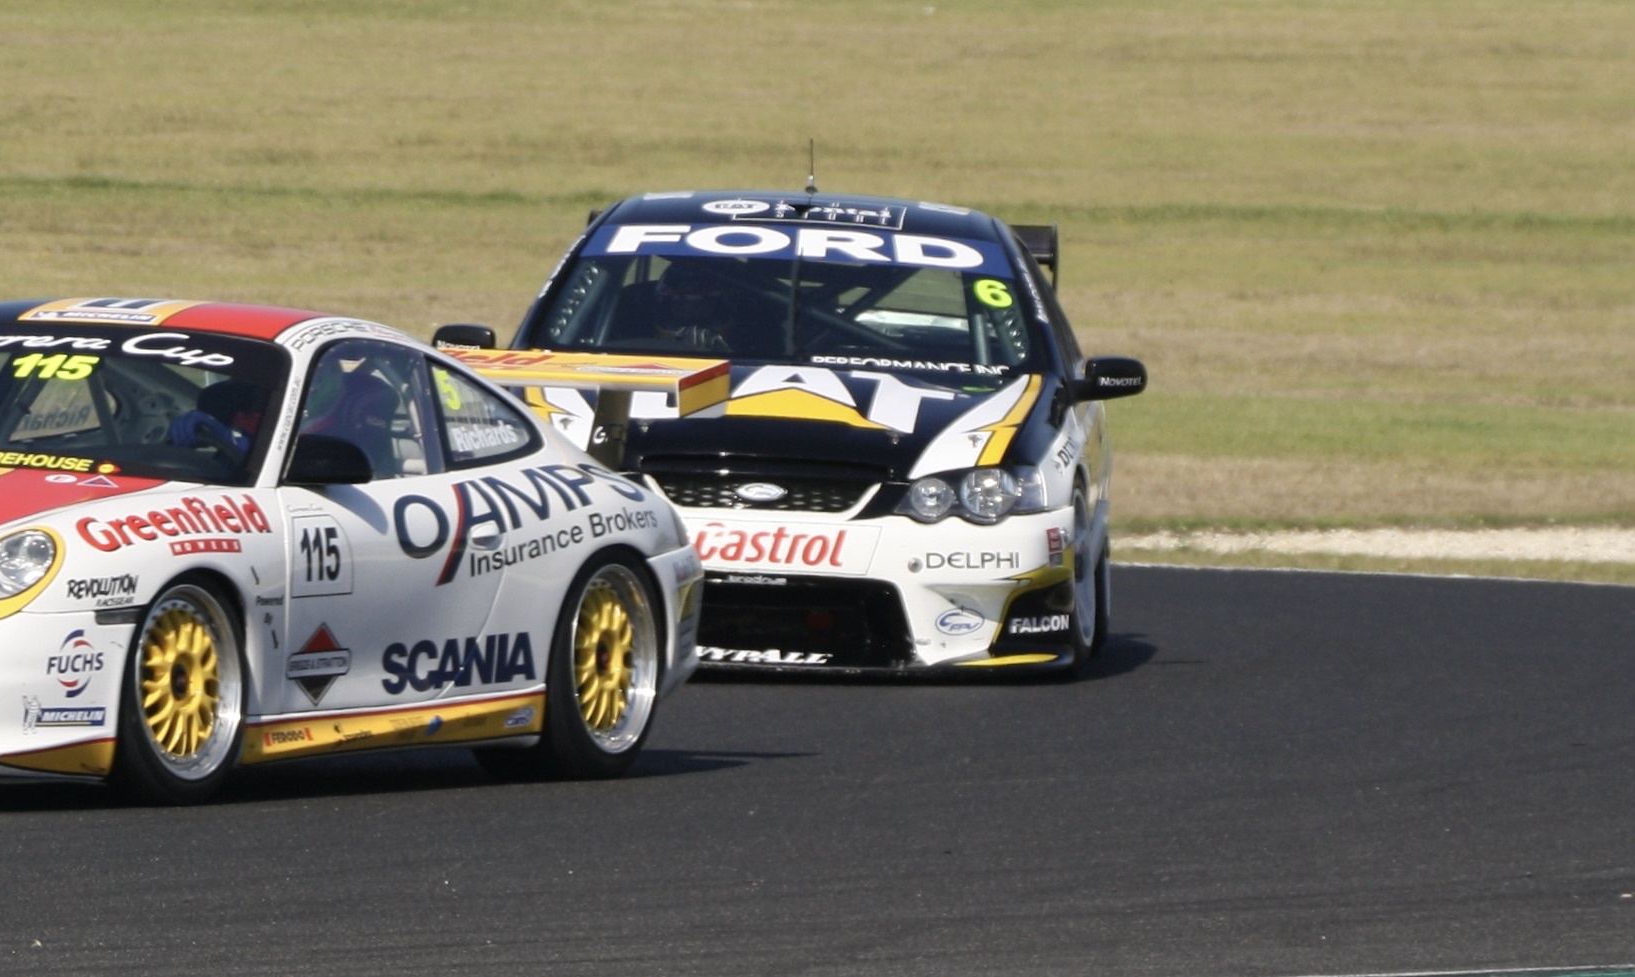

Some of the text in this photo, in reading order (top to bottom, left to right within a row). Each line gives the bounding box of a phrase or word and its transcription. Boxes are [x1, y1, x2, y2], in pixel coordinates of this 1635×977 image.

[606, 225, 984, 268] FORD
[974, 279, 1012, 308] 6
[62, 311, 153, 321] MICHELIN
[121, 332, 234, 366] Cup
[291, 322, 369, 353] PORSCHE
[13, 353, 100, 380] 115
[1098, 377, 1143, 387] NOVOTEL
[628, 365, 955, 434] AT
[451, 420, 517, 452] Richards
[75, 494, 273, 552] Greenfield
[173, 539, 240, 554] MOWERS
[300, 527, 341, 582] 115
[470, 507, 658, 577] Insurance Brokers
[693, 522, 847, 567] Castrol
[925, 551, 1020, 569] DELPHI
[66, 573, 140, 600] REVOLUTION
[1009, 614, 1070, 634] FALCON
[46, 652, 104, 675] FUCHS
[381, 631, 537, 695] SCANIA
[41, 710, 105, 722] MICHELIN
